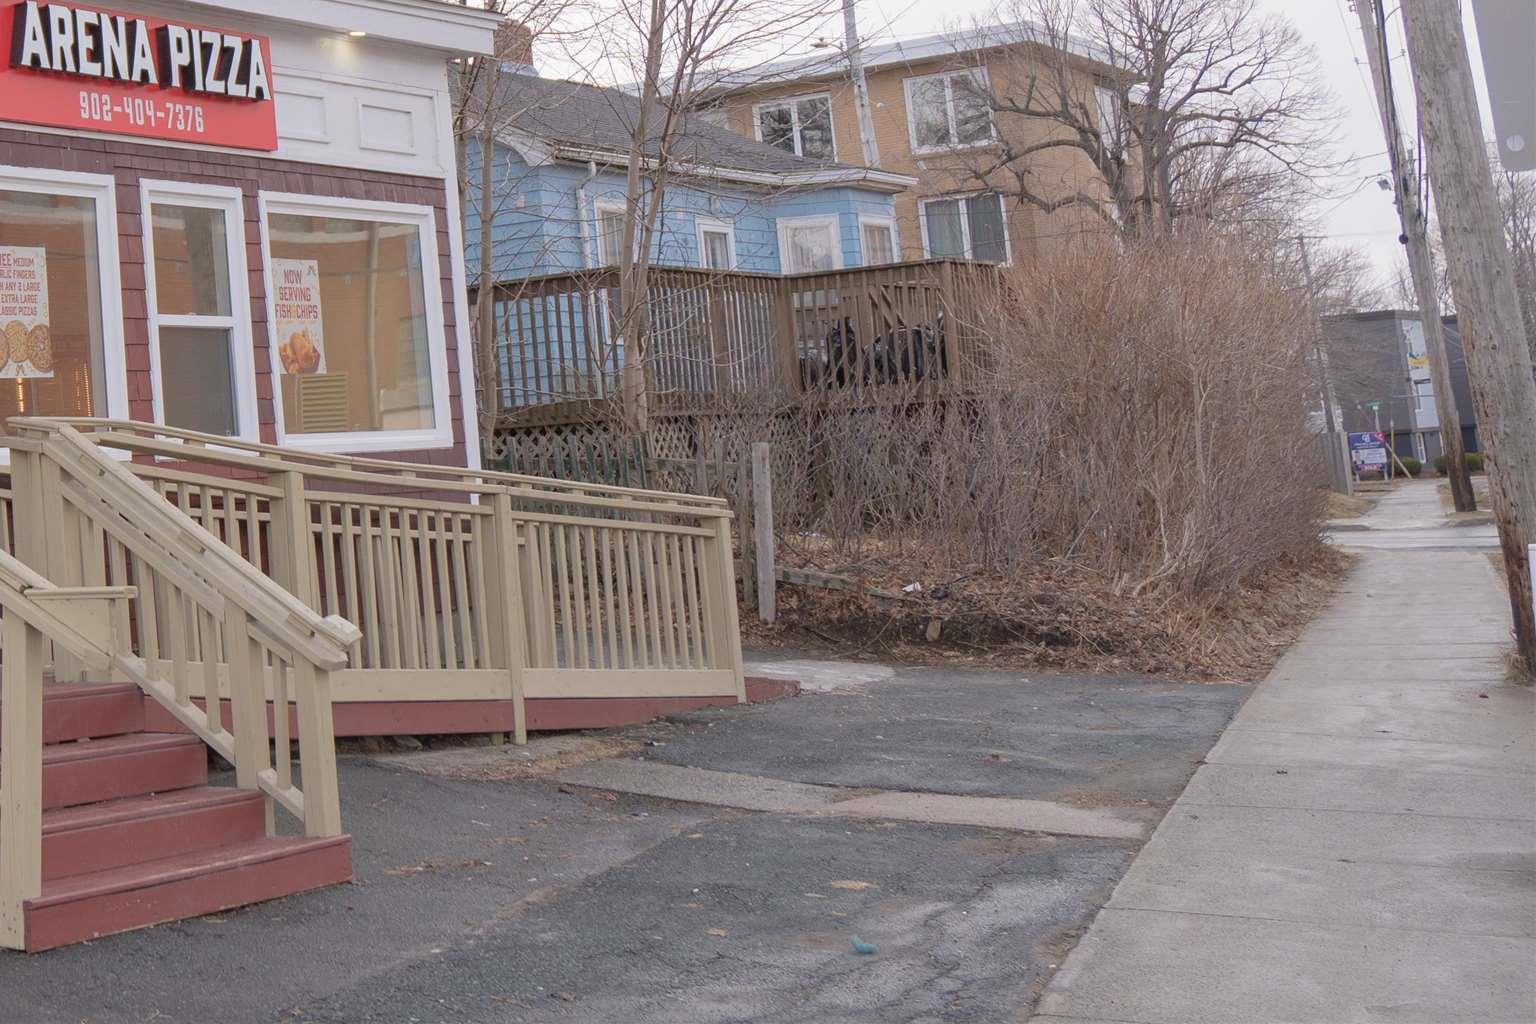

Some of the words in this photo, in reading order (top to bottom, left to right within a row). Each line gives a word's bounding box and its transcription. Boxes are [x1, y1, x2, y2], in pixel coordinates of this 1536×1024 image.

[18, 0, 159, 85] ARENA
[166, 24, 272, 100] PIZZA
[79, 91, 205, 133] 902-404-7376
[283, 269, 302, 284] NOW
[279, 287, 311, 302] SERVING
[275, 304, 292, 320] FISH
[296, 304, 318, 320] CHIPS
